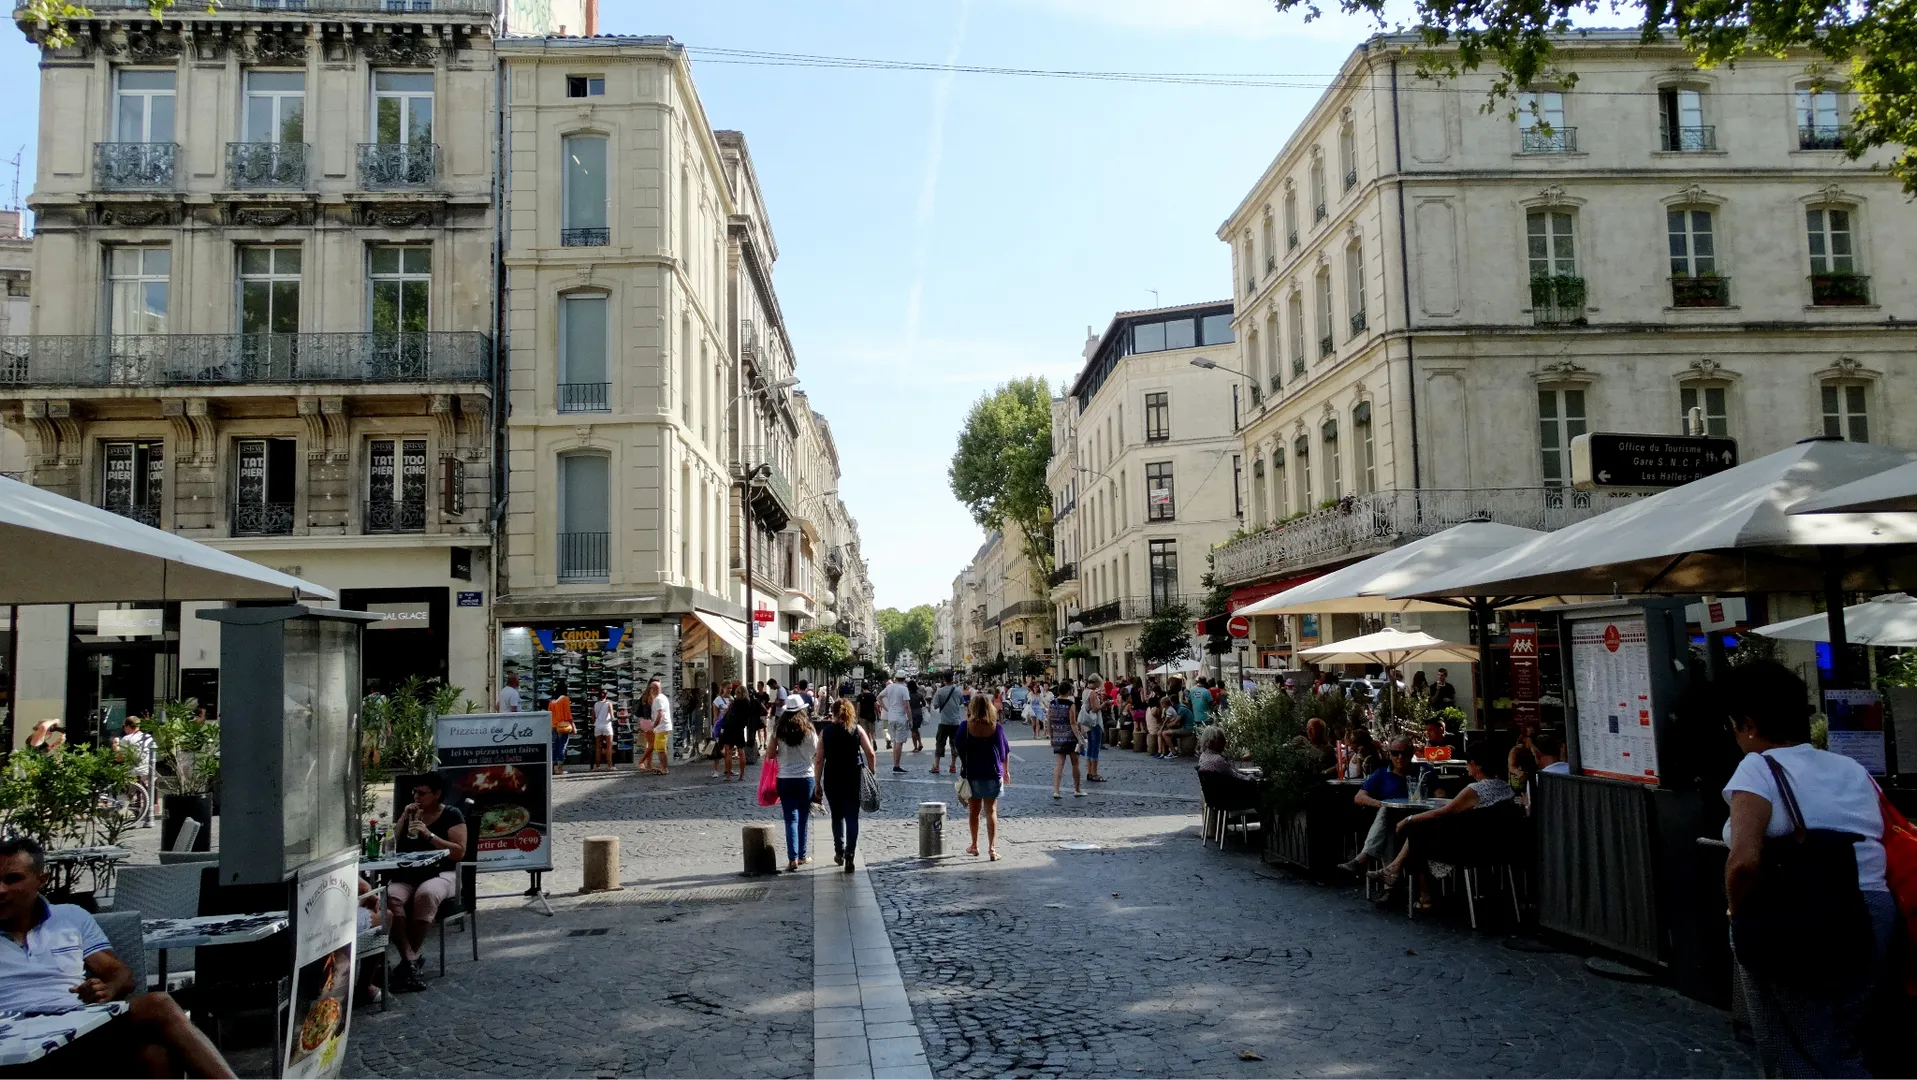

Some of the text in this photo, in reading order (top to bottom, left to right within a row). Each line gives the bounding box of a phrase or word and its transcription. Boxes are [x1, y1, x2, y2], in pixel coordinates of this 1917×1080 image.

[1618, 442, 1702, 453] Office du Tourisme
[110, 459, 132, 471] TAT
[242, 457, 263, 468] TAT
[373, 455, 425, 466] TAT TOO
[1633, 457, 1654, 466] Gare
[107, 470, 131, 480] PIER
[241, 467, 263, 478] PIER
[371, 465, 426, 475] PIER CING
[1641, 471, 1656, 480] Les
[398, 611, 428, 621] GLACE
[561, 630, 600, 640] CANON
[564, 640, 600, 651] SHOES
[449, 726, 488, 737] Pizzeria
[492, 722, 534, 743] Arts
[450, 749, 461, 757] Ici
[462, 748, 474, 756] les
[475, 747, 499, 756] pizzas
[518, 746, 540, 754] faites
[497, 840, 508, 849] de
[518, 836, 539, 845] 7€90
[329, 875, 337, 886] les
